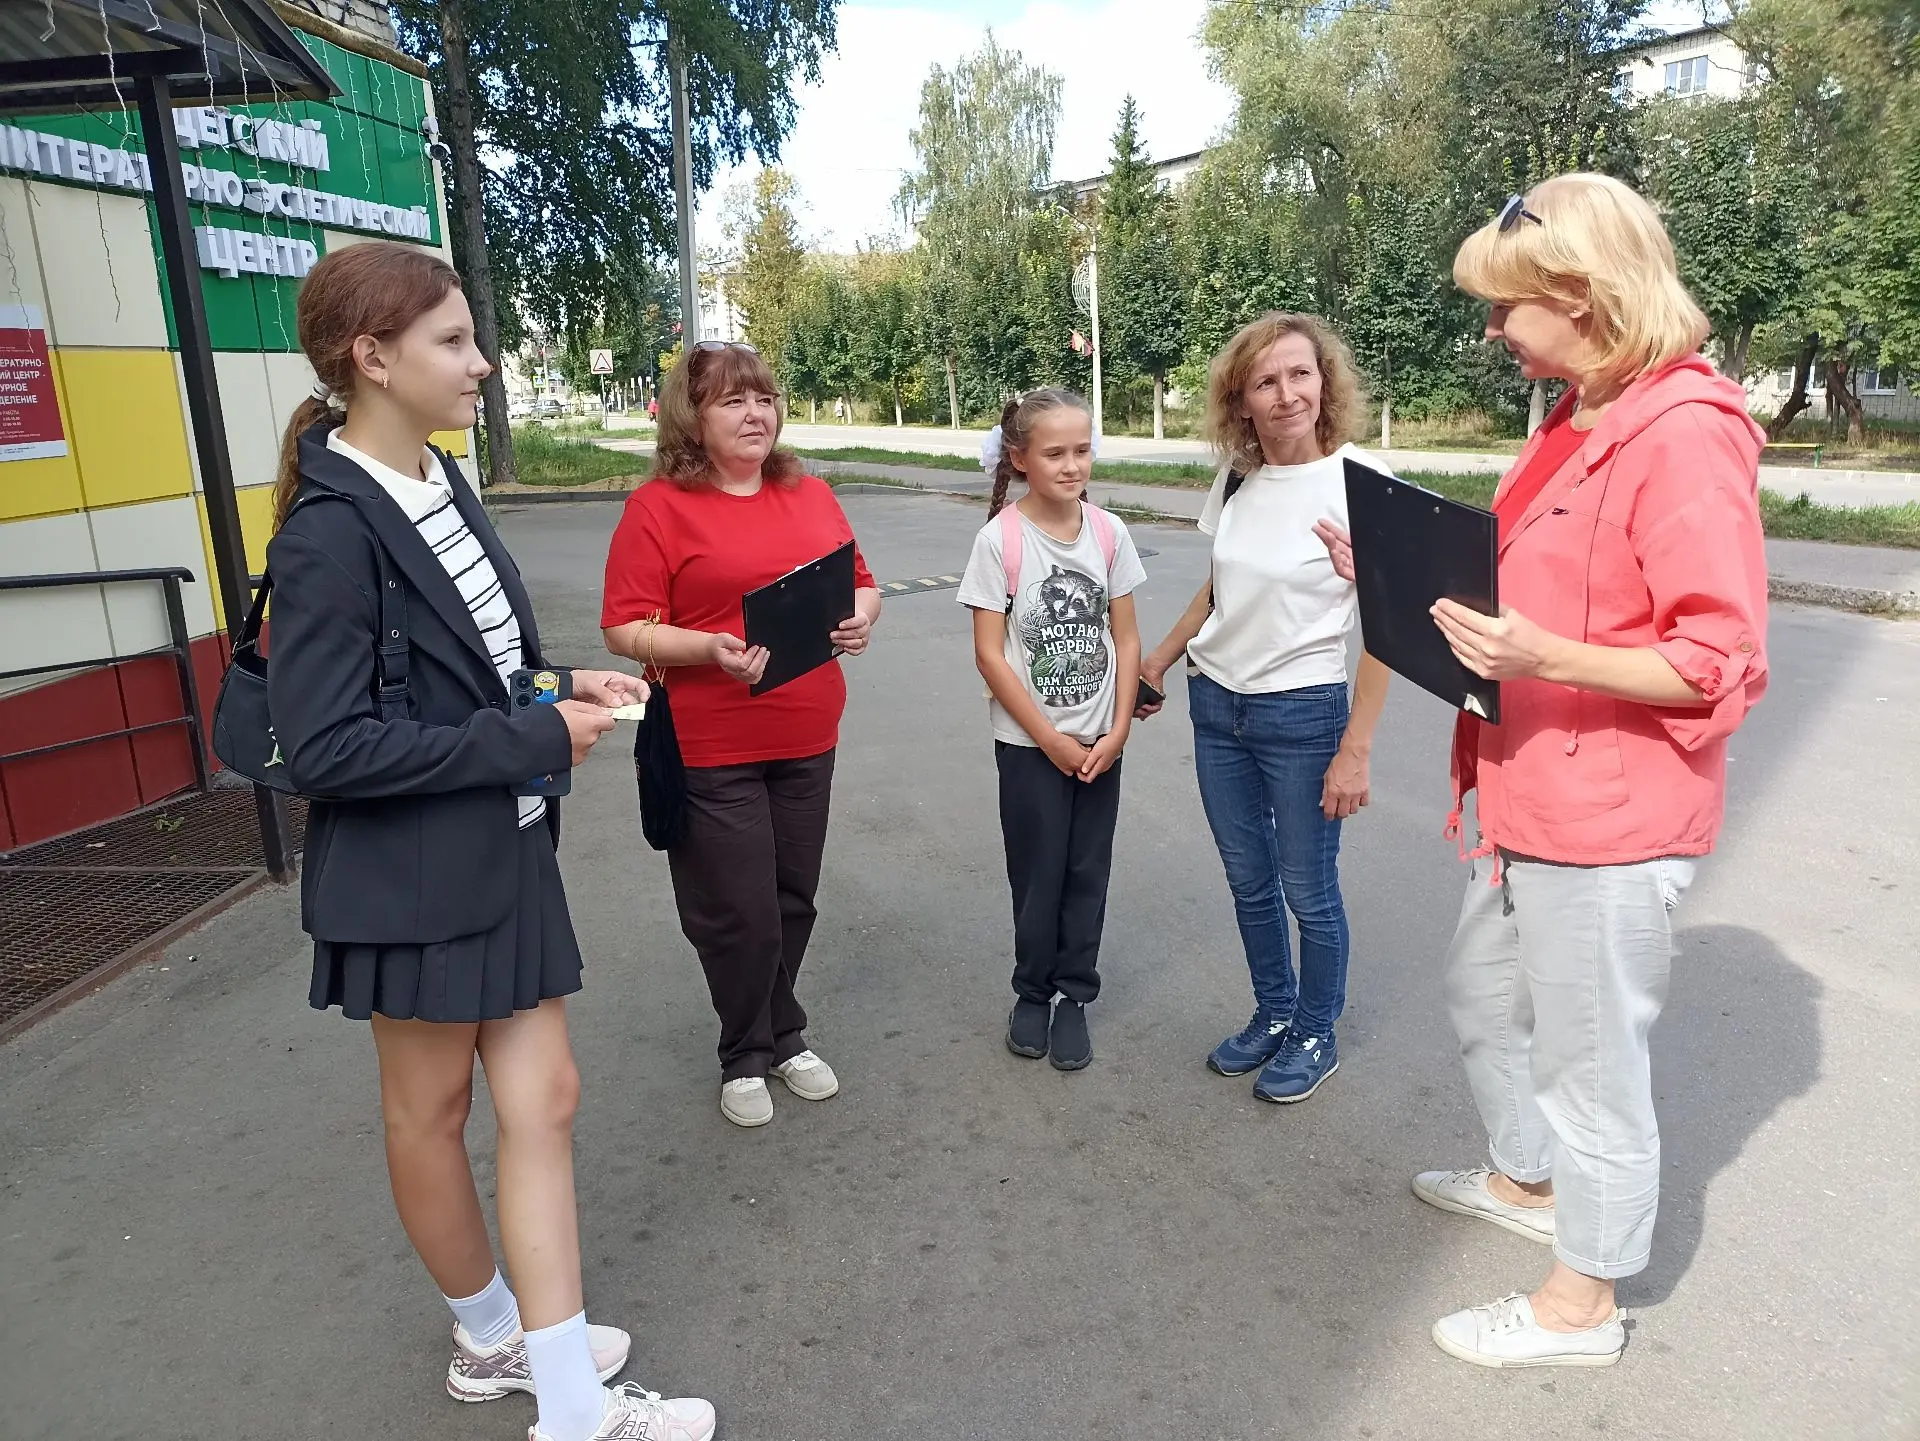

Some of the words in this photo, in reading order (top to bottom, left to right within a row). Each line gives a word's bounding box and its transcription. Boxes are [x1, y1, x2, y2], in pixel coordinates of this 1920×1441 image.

[196, 226, 318, 278] ЦЕНТР
[13, 370, 40, 381] ЦЕНТР
[1040, 623, 1099, 641] МОТАЮ
[1044, 640, 1097, 656] НЕРВЫ
[1036, 676, 1060, 686] ВАМ
[1065, 670, 1104, 686] СКОЛЬКО
[1042, 680, 1102, 696] КЛУБОЧКОВ?
